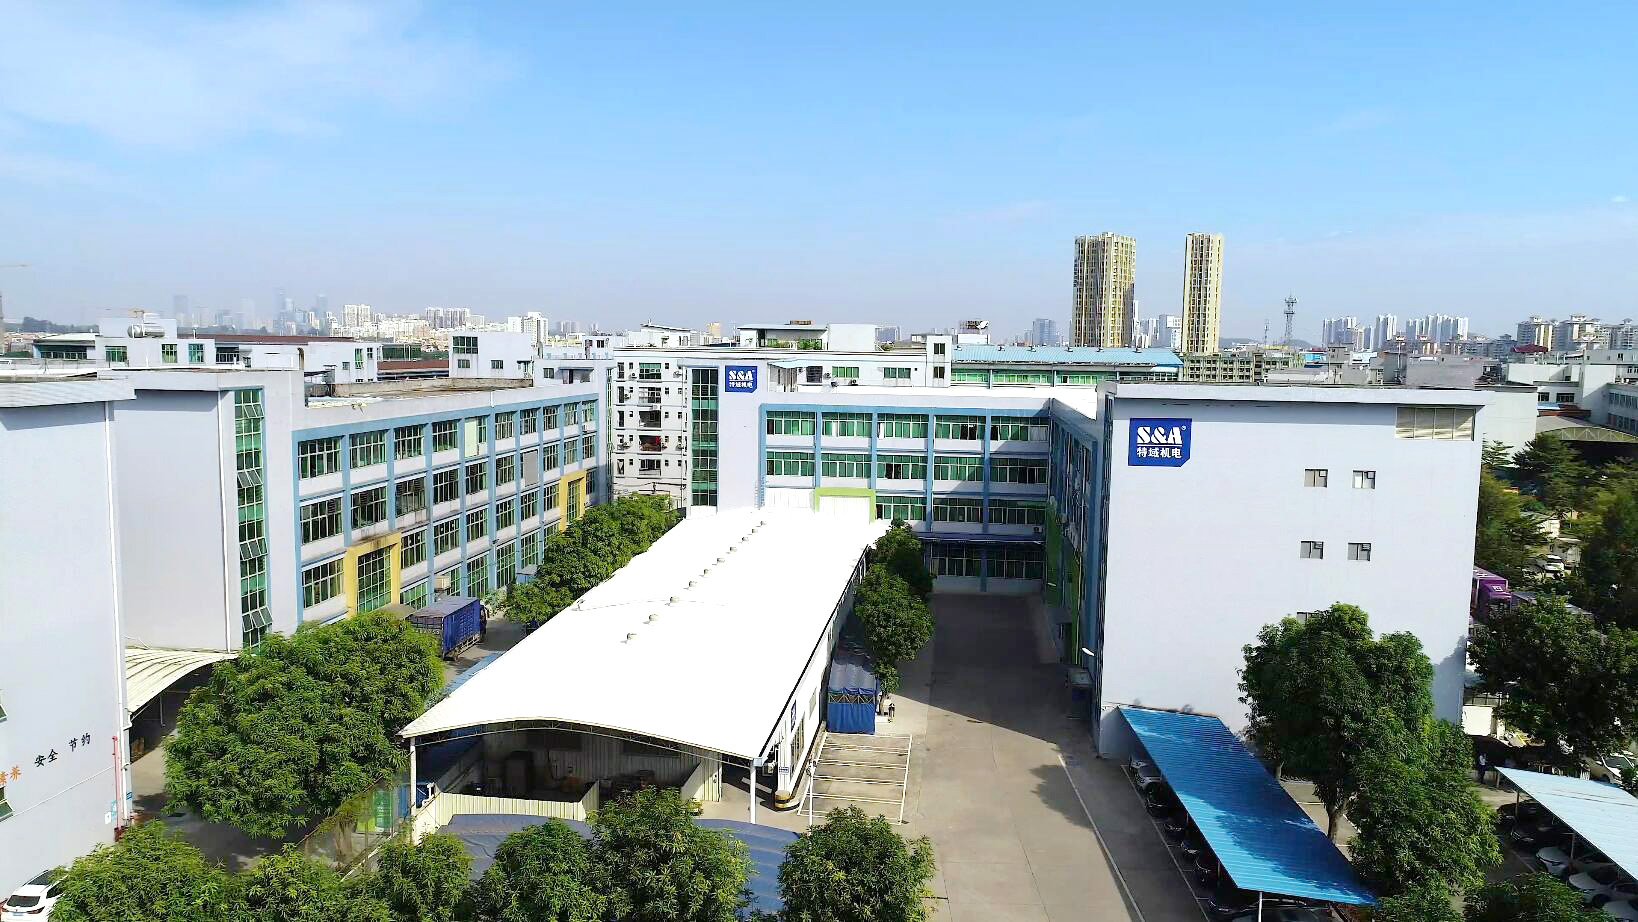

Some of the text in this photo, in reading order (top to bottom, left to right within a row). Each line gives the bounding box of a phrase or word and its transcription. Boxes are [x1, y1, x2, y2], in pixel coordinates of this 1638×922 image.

[729, 370, 753, 380] S&A
[1137, 427, 1182, 444] S&A
[1137, 447, 1182, 458] 特域机电
[34, 749, 58, 768] 安全
[68, 732, 91, 752] 节约
